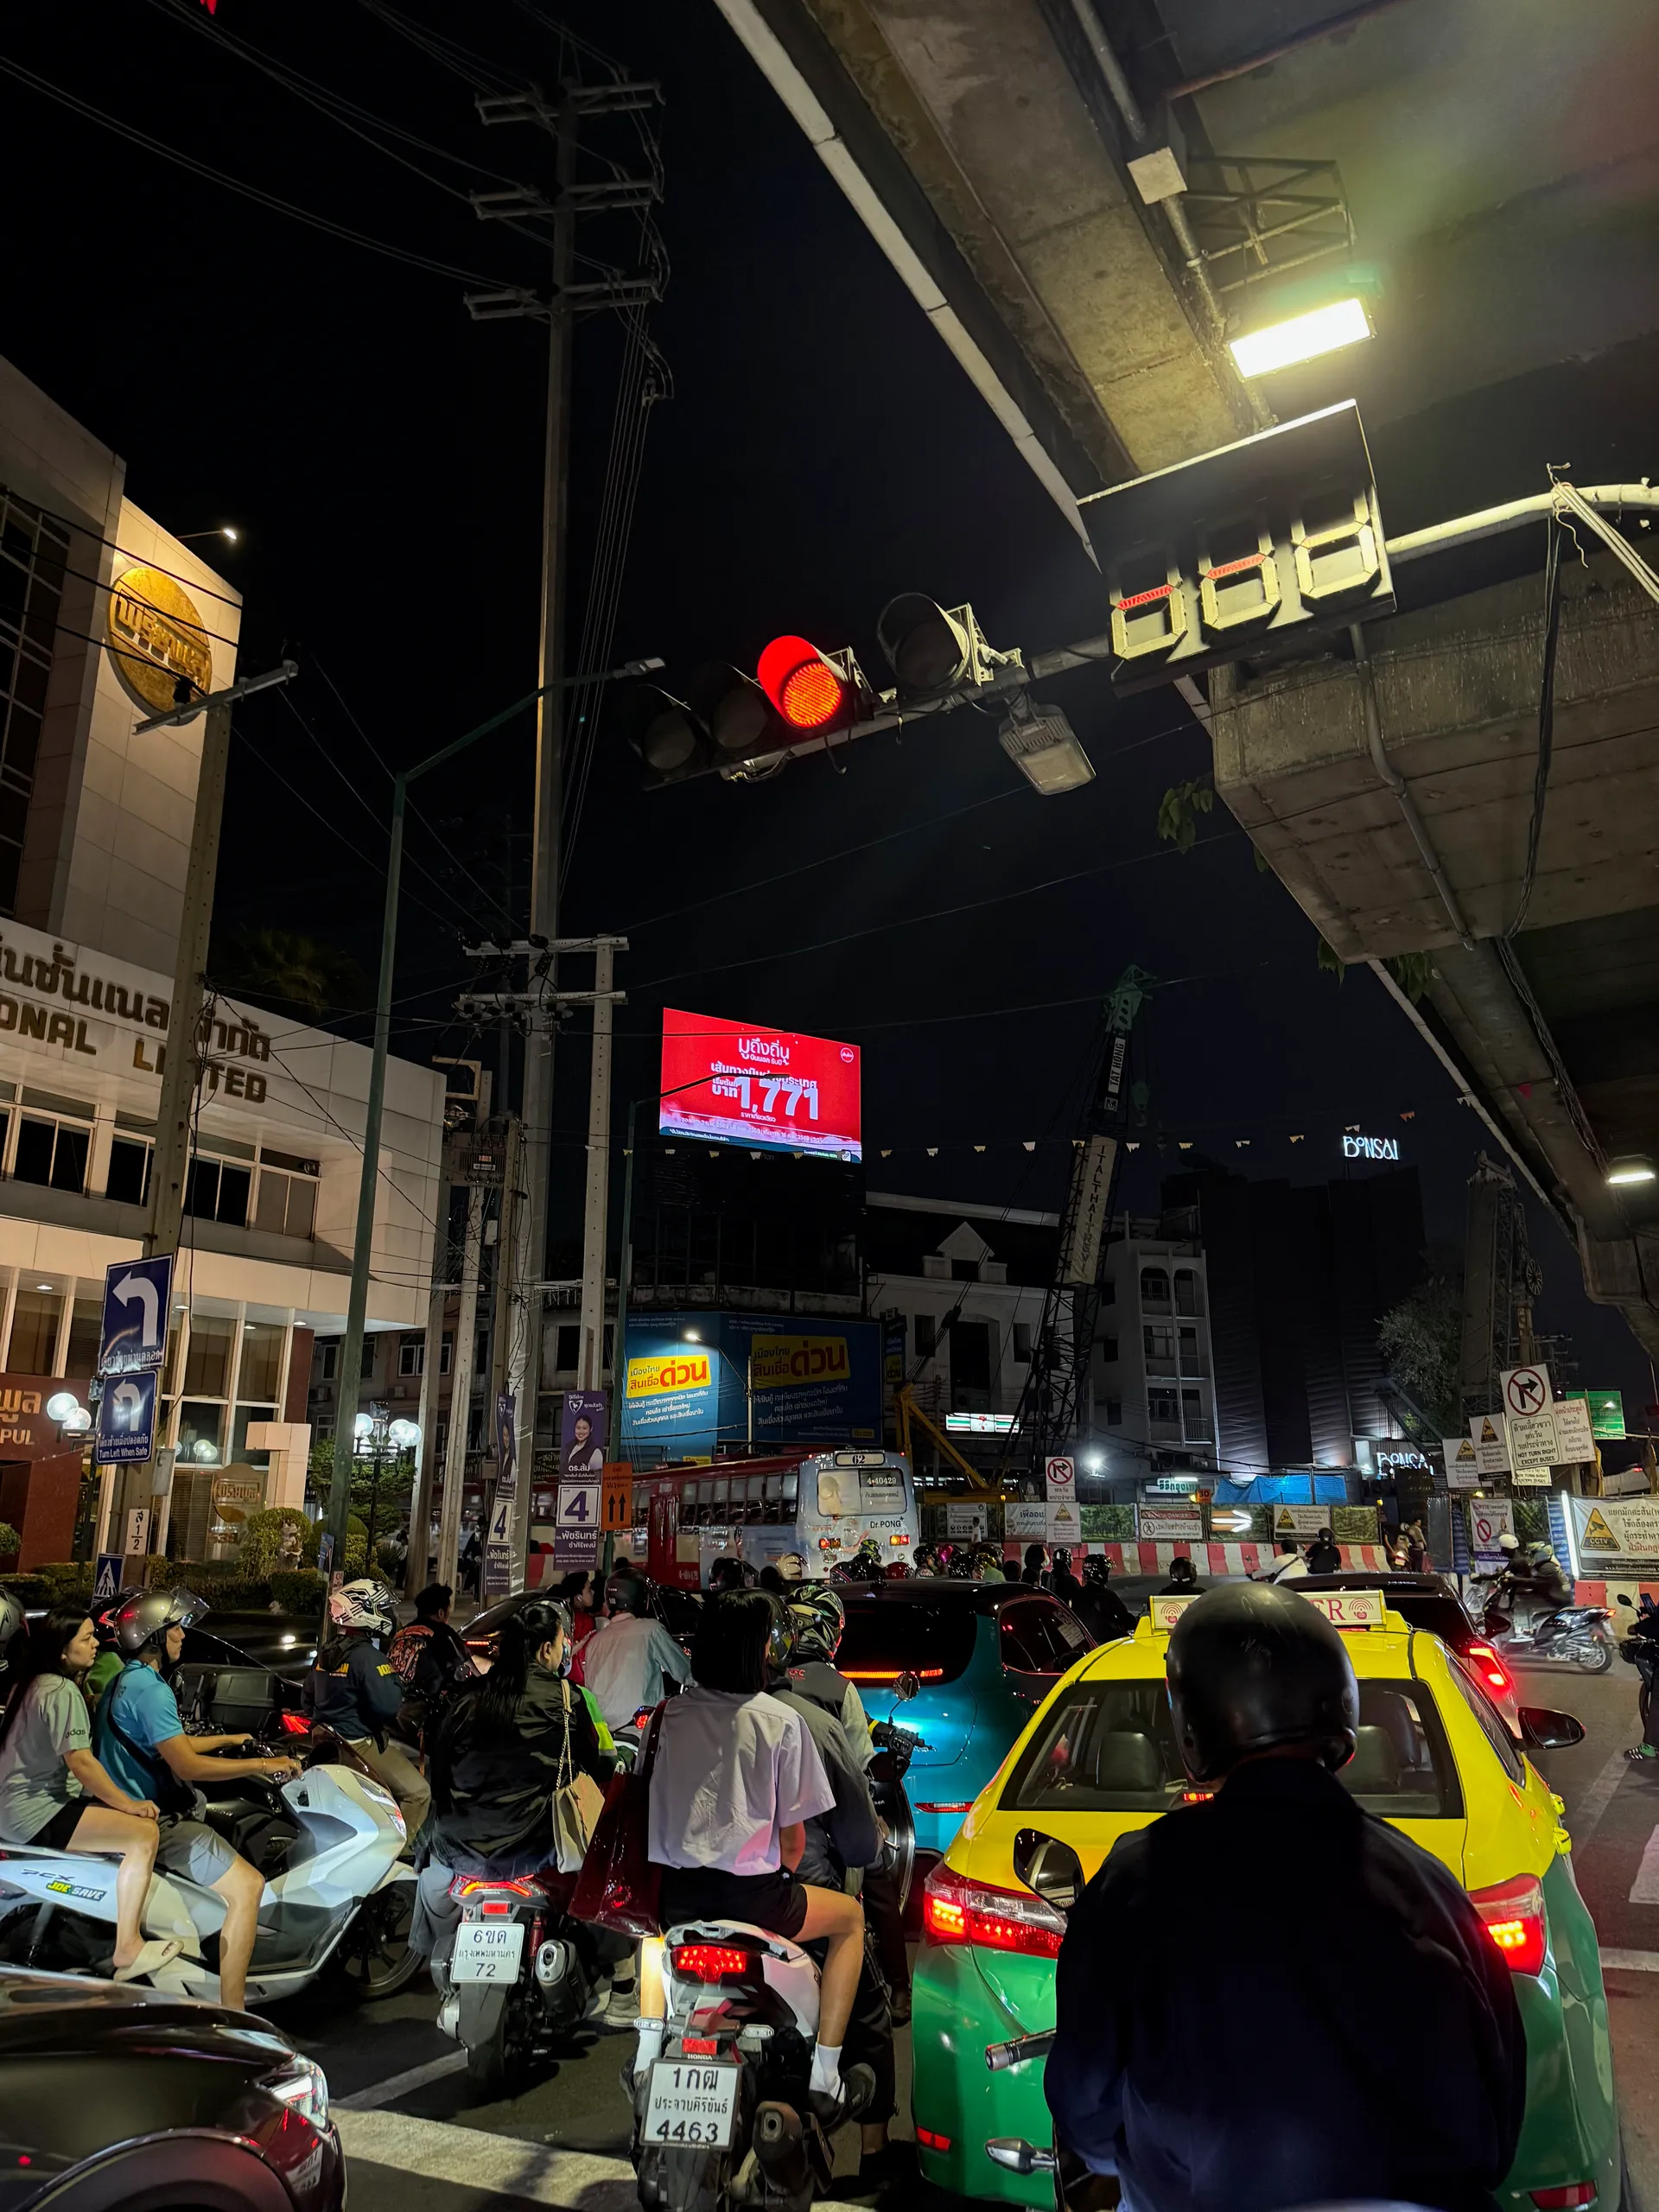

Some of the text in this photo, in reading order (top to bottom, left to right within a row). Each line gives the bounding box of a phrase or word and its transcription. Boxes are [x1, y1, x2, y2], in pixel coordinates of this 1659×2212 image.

[0, 935, 171, 1031] นชั่นแนล
[133, 1039, 267, 1103] LITED
[1109, 1043, 1125, 1086] TAT HONG
[712, 1084, 737, 1098] บาท
[735, 1077, 819, 1121] 1,771
[1343, 1135, 1399, 1160] BONSAI
[791, 1340, 845, 1377] ด่วน
[630, 1374, 659, 1389] สินเชื่อ
[660, 1360, 707, 1388] ด่วน
[1513, 1419, 1552, 1432] ห้ามเลี้ยวขวา
[99, 1445, 148, 1459] Turn Left When Safe
[1517, 1438, 1554, 1450] รถประจำทาง
[852, 1454, 865, 1465] 62
[564, 1491, 589, 1522] 4
[493, 1504, 507, 1540] 4
[133, 1539, 140, 1550] 2
[22, 1868, 75, 1881] PCX
[48, 1881, 105, 1899] JOE SAVE
[474, 1929, 506, 1943] 6ขด
[459, 1949, 516, 1961] กรุงเทพมหานคร
[475, 1963, 496, 1977] 72
[656, 2120, 718, 2143] 4463
